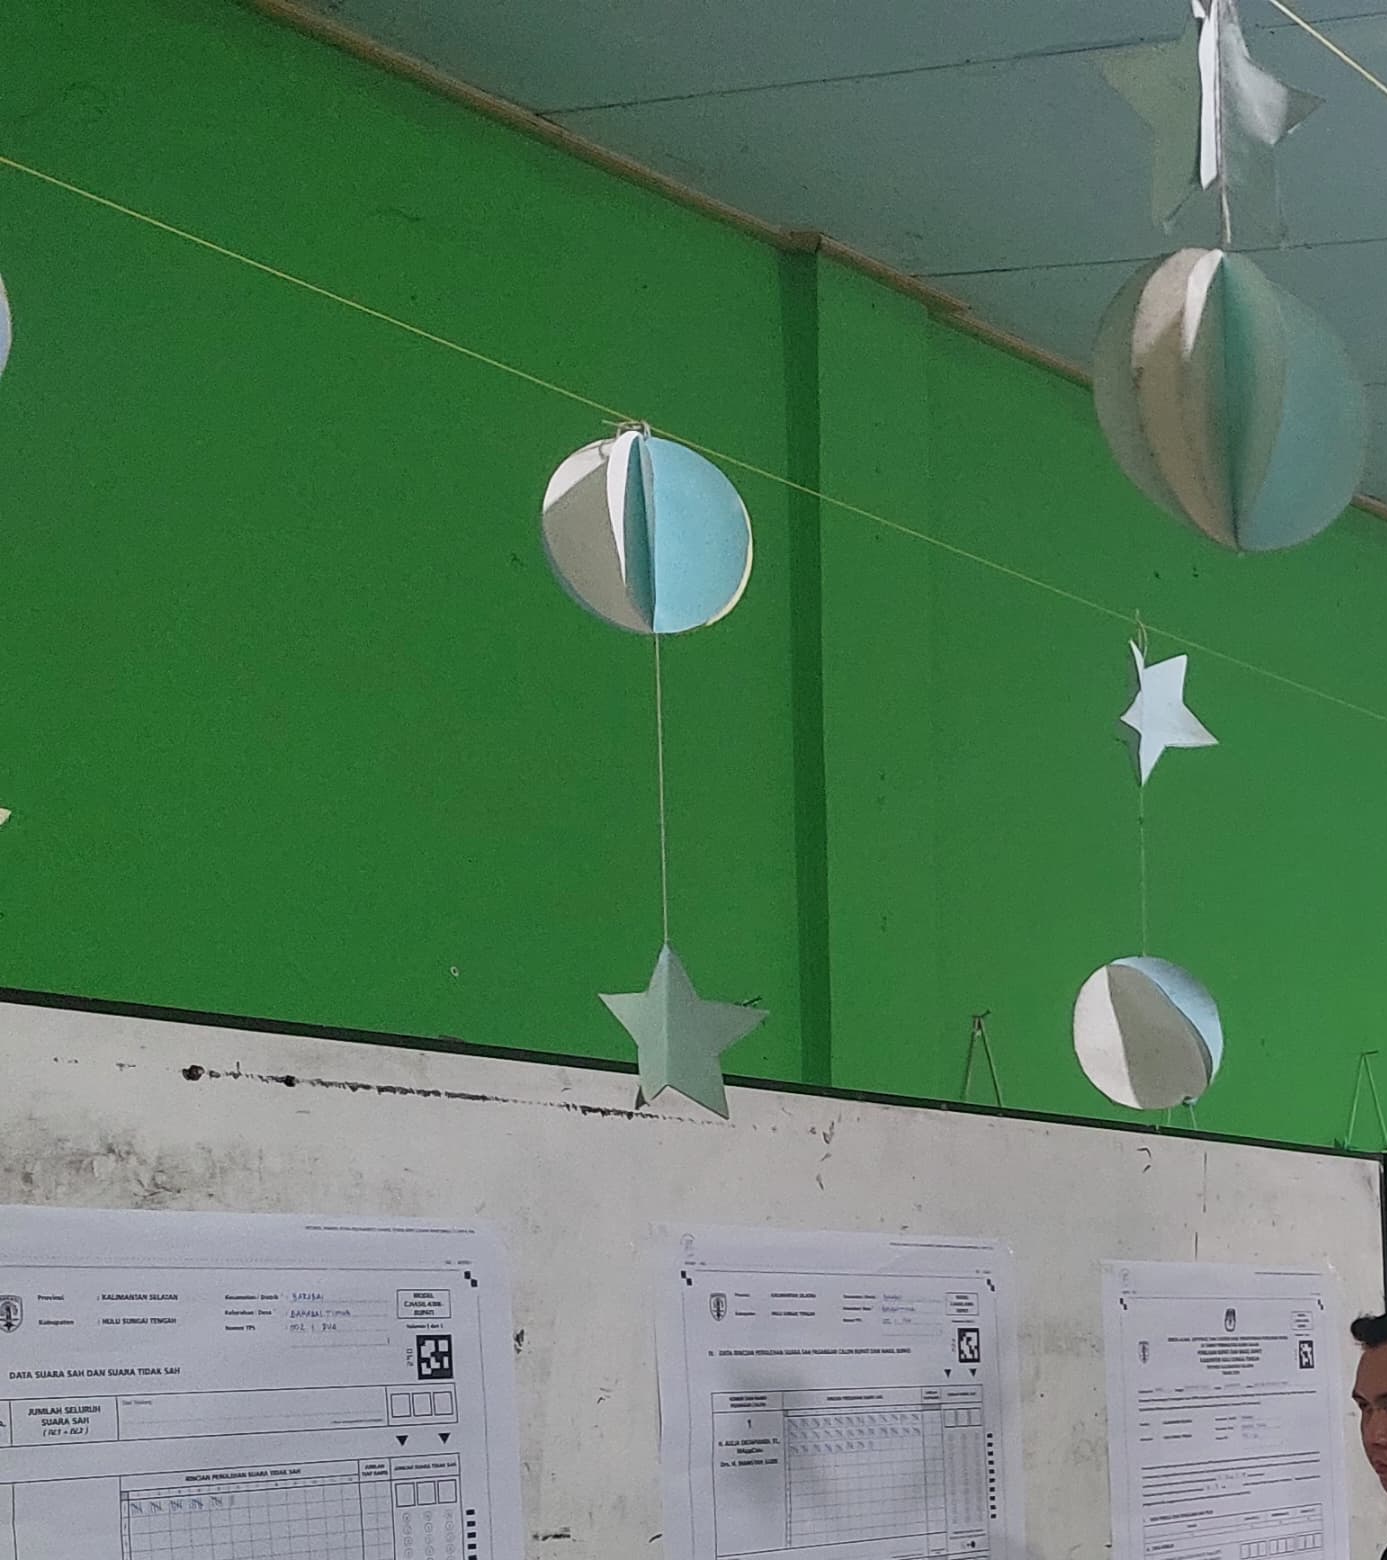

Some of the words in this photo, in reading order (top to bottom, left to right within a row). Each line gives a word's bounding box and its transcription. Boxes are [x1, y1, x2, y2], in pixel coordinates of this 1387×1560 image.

[9, 1371, 33, 1380] DATA
[35, 1370, 65, 1379] SUARA
[67, 1369, 85, 1378] SAH
[86, 1369, 106, 1378] DAN
[107, 1368, 136, 1377] SUARA
[138, 1367, 162, 1376] TIDAK
[164, 1367, 181, 1375] SAH
[28, 1406, 62, 1416] JUMLAH
[64, 1405, 101, 1415] SELURUH
[41, 1418, 70, 1427] SUARA
[72, 1416, 89, 1425] SAH
